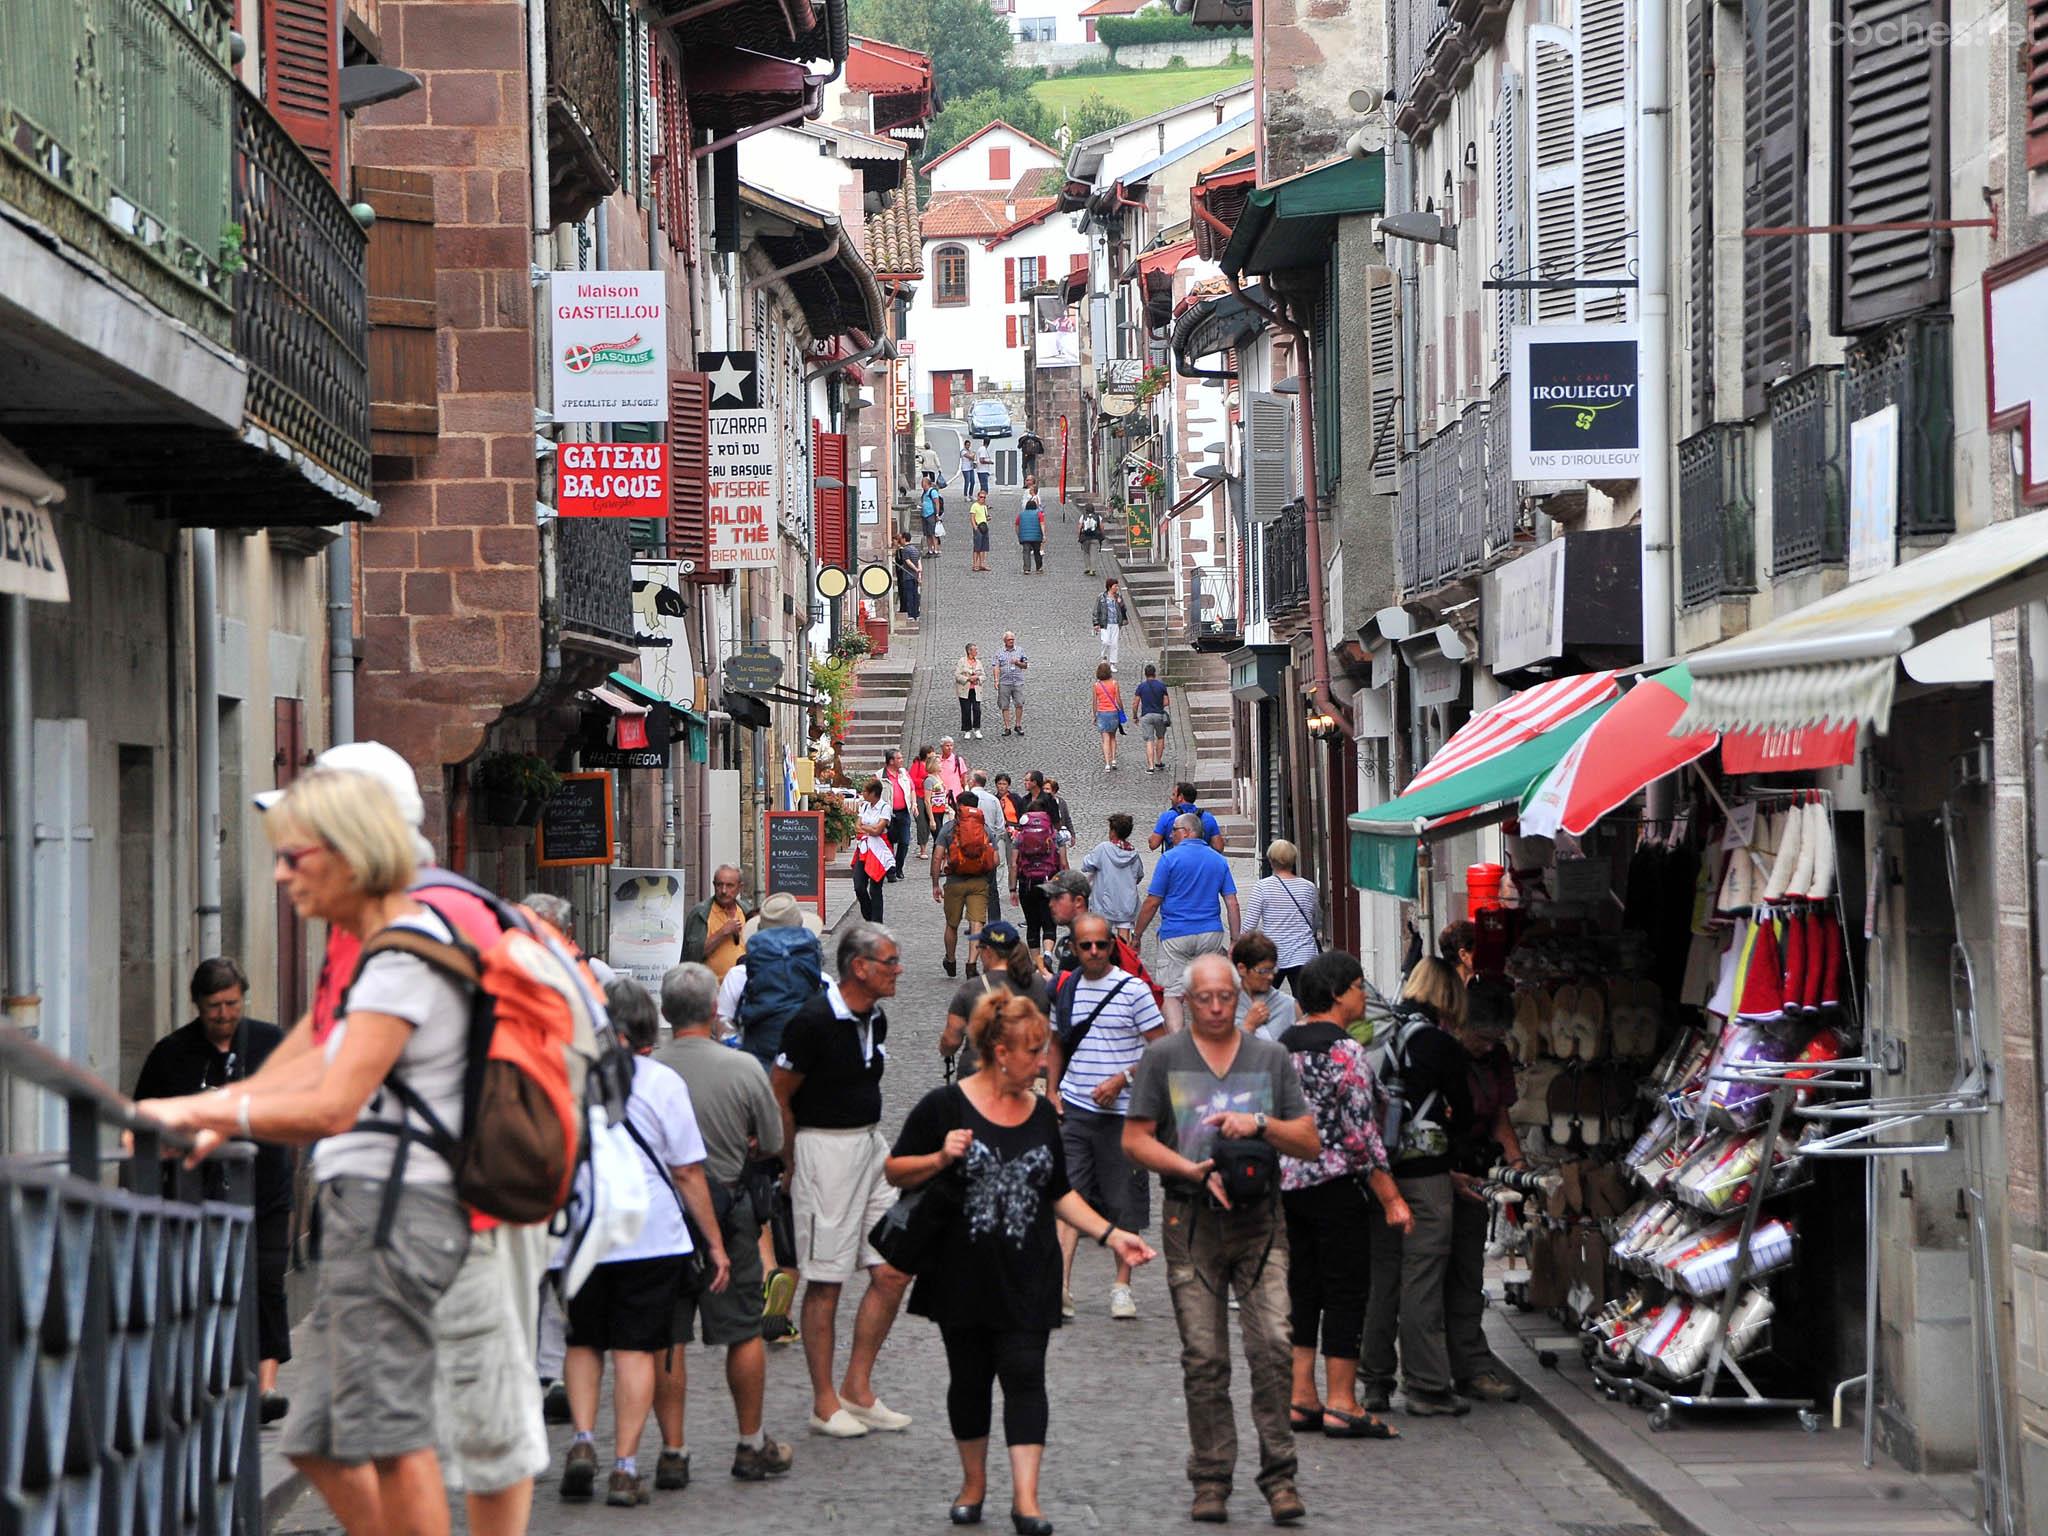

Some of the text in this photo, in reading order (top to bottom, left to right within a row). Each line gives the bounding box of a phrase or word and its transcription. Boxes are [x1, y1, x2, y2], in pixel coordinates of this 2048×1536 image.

[578, 284, 640, 298] Maison
[558, 305, 660, 320] GASTELLOU
[594, 352, 649, 364] BASQUAISE
[1532, 383, 1635, 399] IROULEGUY
[742, 443, 760, 456] DU
[563, 446, 662, 470] GATEAU
[1529, 453, 1640, 466] VINS D'IROULEGUY
[731, 464, 773, 479] BASQUE
[563, 474, 662, 498] BASQUE
[861, 500, 875, 510] EA
[731, 523, 769, 544] THÉ
[629, 752, 662, 766] HEGOA
